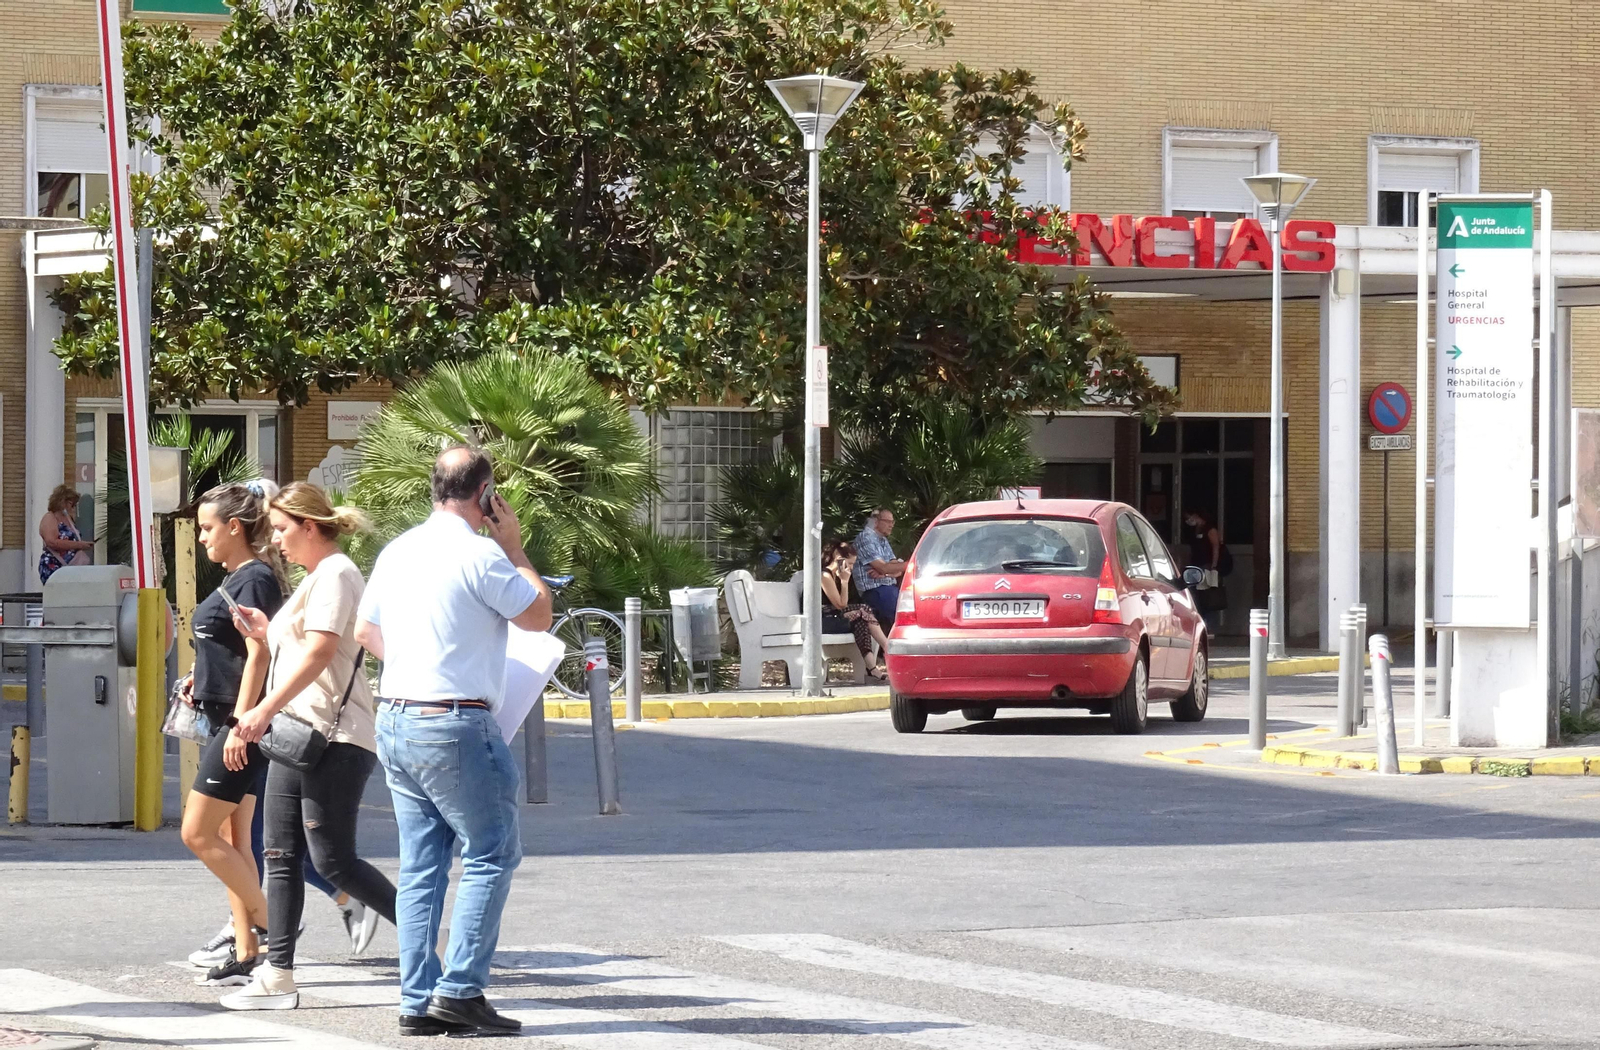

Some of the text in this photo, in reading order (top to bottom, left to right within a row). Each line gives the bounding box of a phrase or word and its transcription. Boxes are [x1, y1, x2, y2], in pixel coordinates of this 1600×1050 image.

[1470, 217, 1496, 226] Junta
[1470, 225, 1526, 235] de Andalucía
[1447, 289, 1488, 299] Hospital
[1447, 301, 1485, 310] General
[1448, 316, 1505, 325] URGENCIAS
[1447, 366, 1501, 376] Hospital de
[1446, 378, 1524, 389] Rehabilitación y
[1446, 389, 1516, 401] Traumatología
[973, 602, 1040, 616] 5300 DZJ
